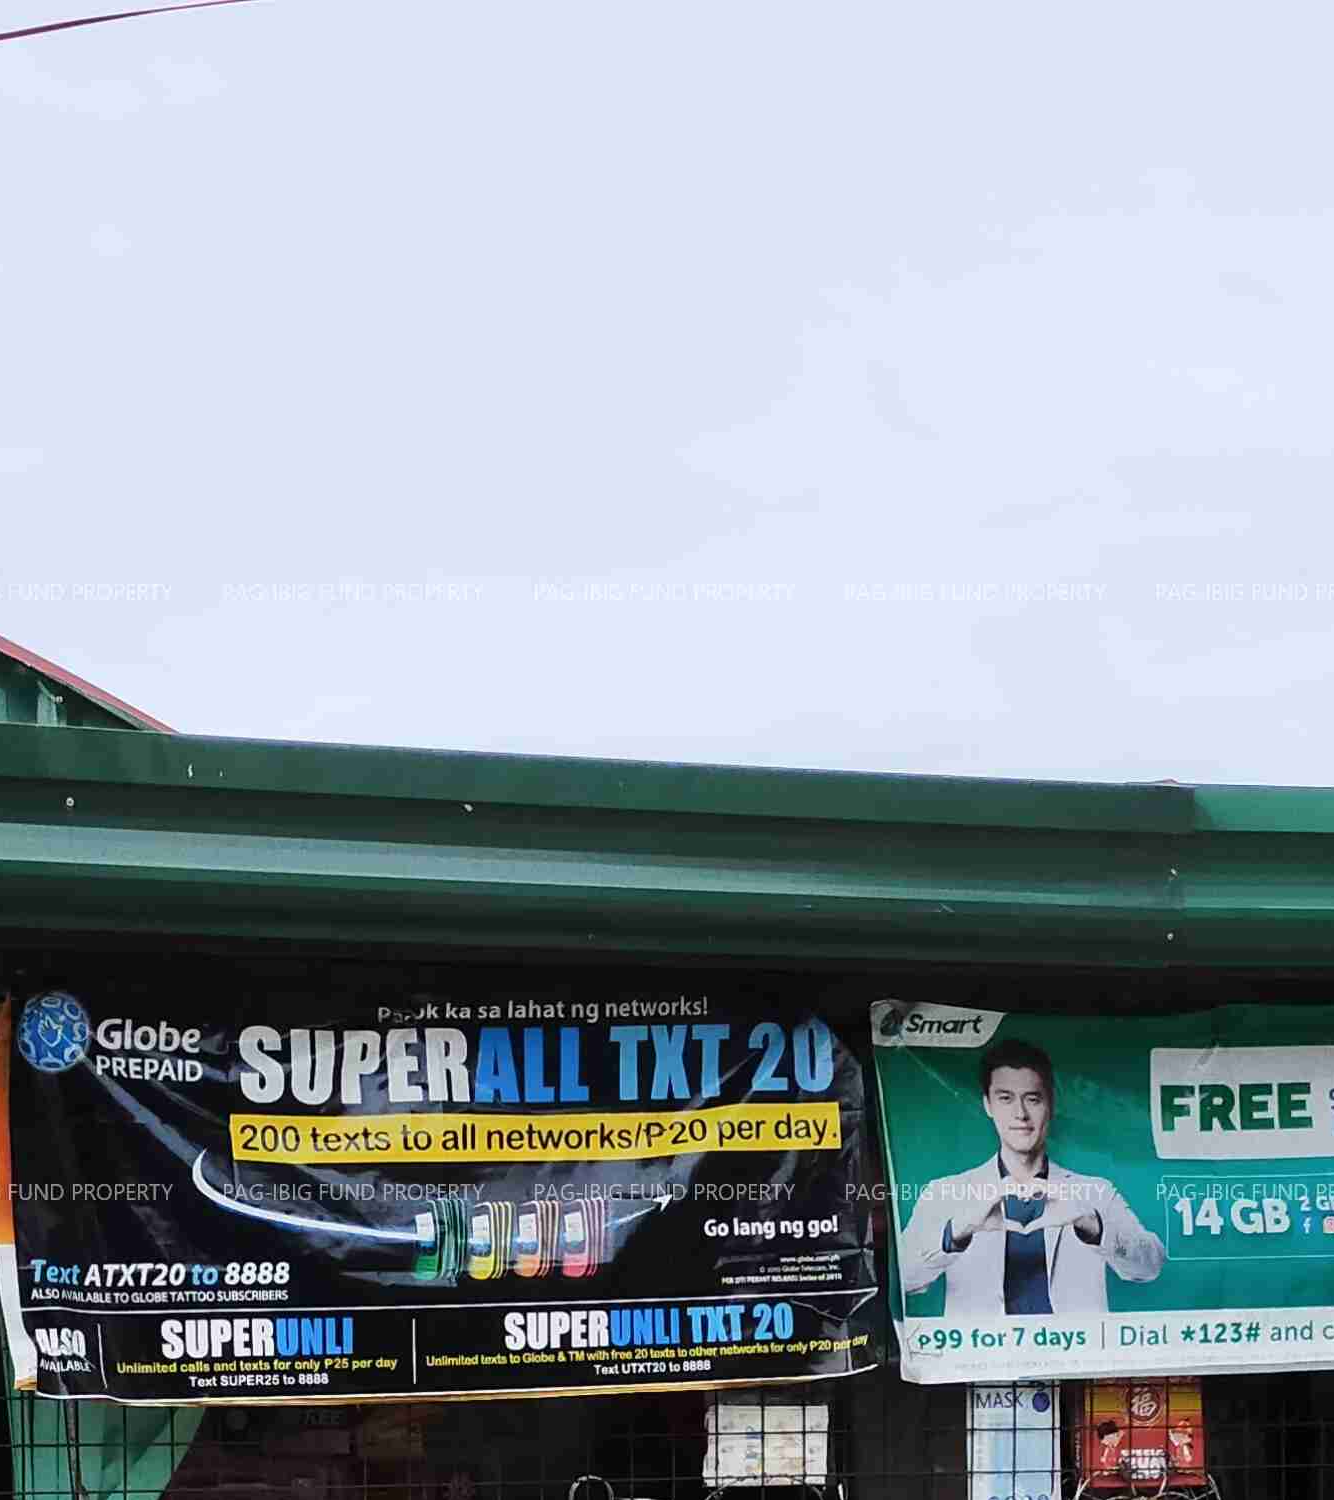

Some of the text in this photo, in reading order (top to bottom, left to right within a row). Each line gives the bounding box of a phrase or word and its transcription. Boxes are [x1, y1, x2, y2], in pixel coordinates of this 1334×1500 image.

[445, 997, 708, 1024] ka sa lahat ng networks!
[905, 1013, 983, 1034] Smart
[96, 1018, 201, 1054] Globe
[96, 1055, 204, 1083] PREPAID
[238, 1016, 836, 1105] SUPERALL TXT 20
[1160, 1081, 1314, 1132] FREE
[239, 1113, 838, 1153] 200 texts to all per day.
[703, 1214, 839, 1240] Go lang ng go!
[30, 1259, 291, 1288] Text ATXT20 to 8888
[31, 1288, 289, 1304] ALSO AVAILABLE TO GLOBE TATTOO SUBSCRIBERS
[161, 1317, 354, 1359] SUPERUNLI
[504, 1302, 794, 1351] SUPERUNLI TXT 20
[971, 1328, 1008, 1348] for
[1013, 1328, 1025, 1347] 7
[1033, 1325, 1086, 1350] days
[1120, 1325, 1168, 1347] Dial
[1270, 1320, 1314, 1342] and
[426, 1354, 478, 1367] Unlimited
[479, 1354, 508, 1366] texts
[509, 1354, 520, 1365] to
[522, 1351, 555, 1365] Globe
[556, 1351, 566, 1362] &
[568, 1350, 585, 1362] TM
[586, 1350, 610, 1362] with
[610, 1348, 633, 1361] free
[634, 1348, 648, 1360] 20
[649, 1347, 676, 1360] texts
[676, 1347, 687, 1358] to
[688, 1345, 717, 1358] other
[719, 1343, 769, 1357] networks
[770, 1342, 785, 1354] for
[786, 1341, 809, 1356] only
[851, 1334, 869, 1348] day
[39, 1357, 92, 1374] AVAILABLE
[117, 1357, 398, 1375] Unlimited calls and texts for only per day
[593, 1360, 711, 1375] Text UTXT20 to 8888
[189, 1373, 329, 1388] Text SUPER25 to 8888
[975, 1391, 1024, 1409] MASK
